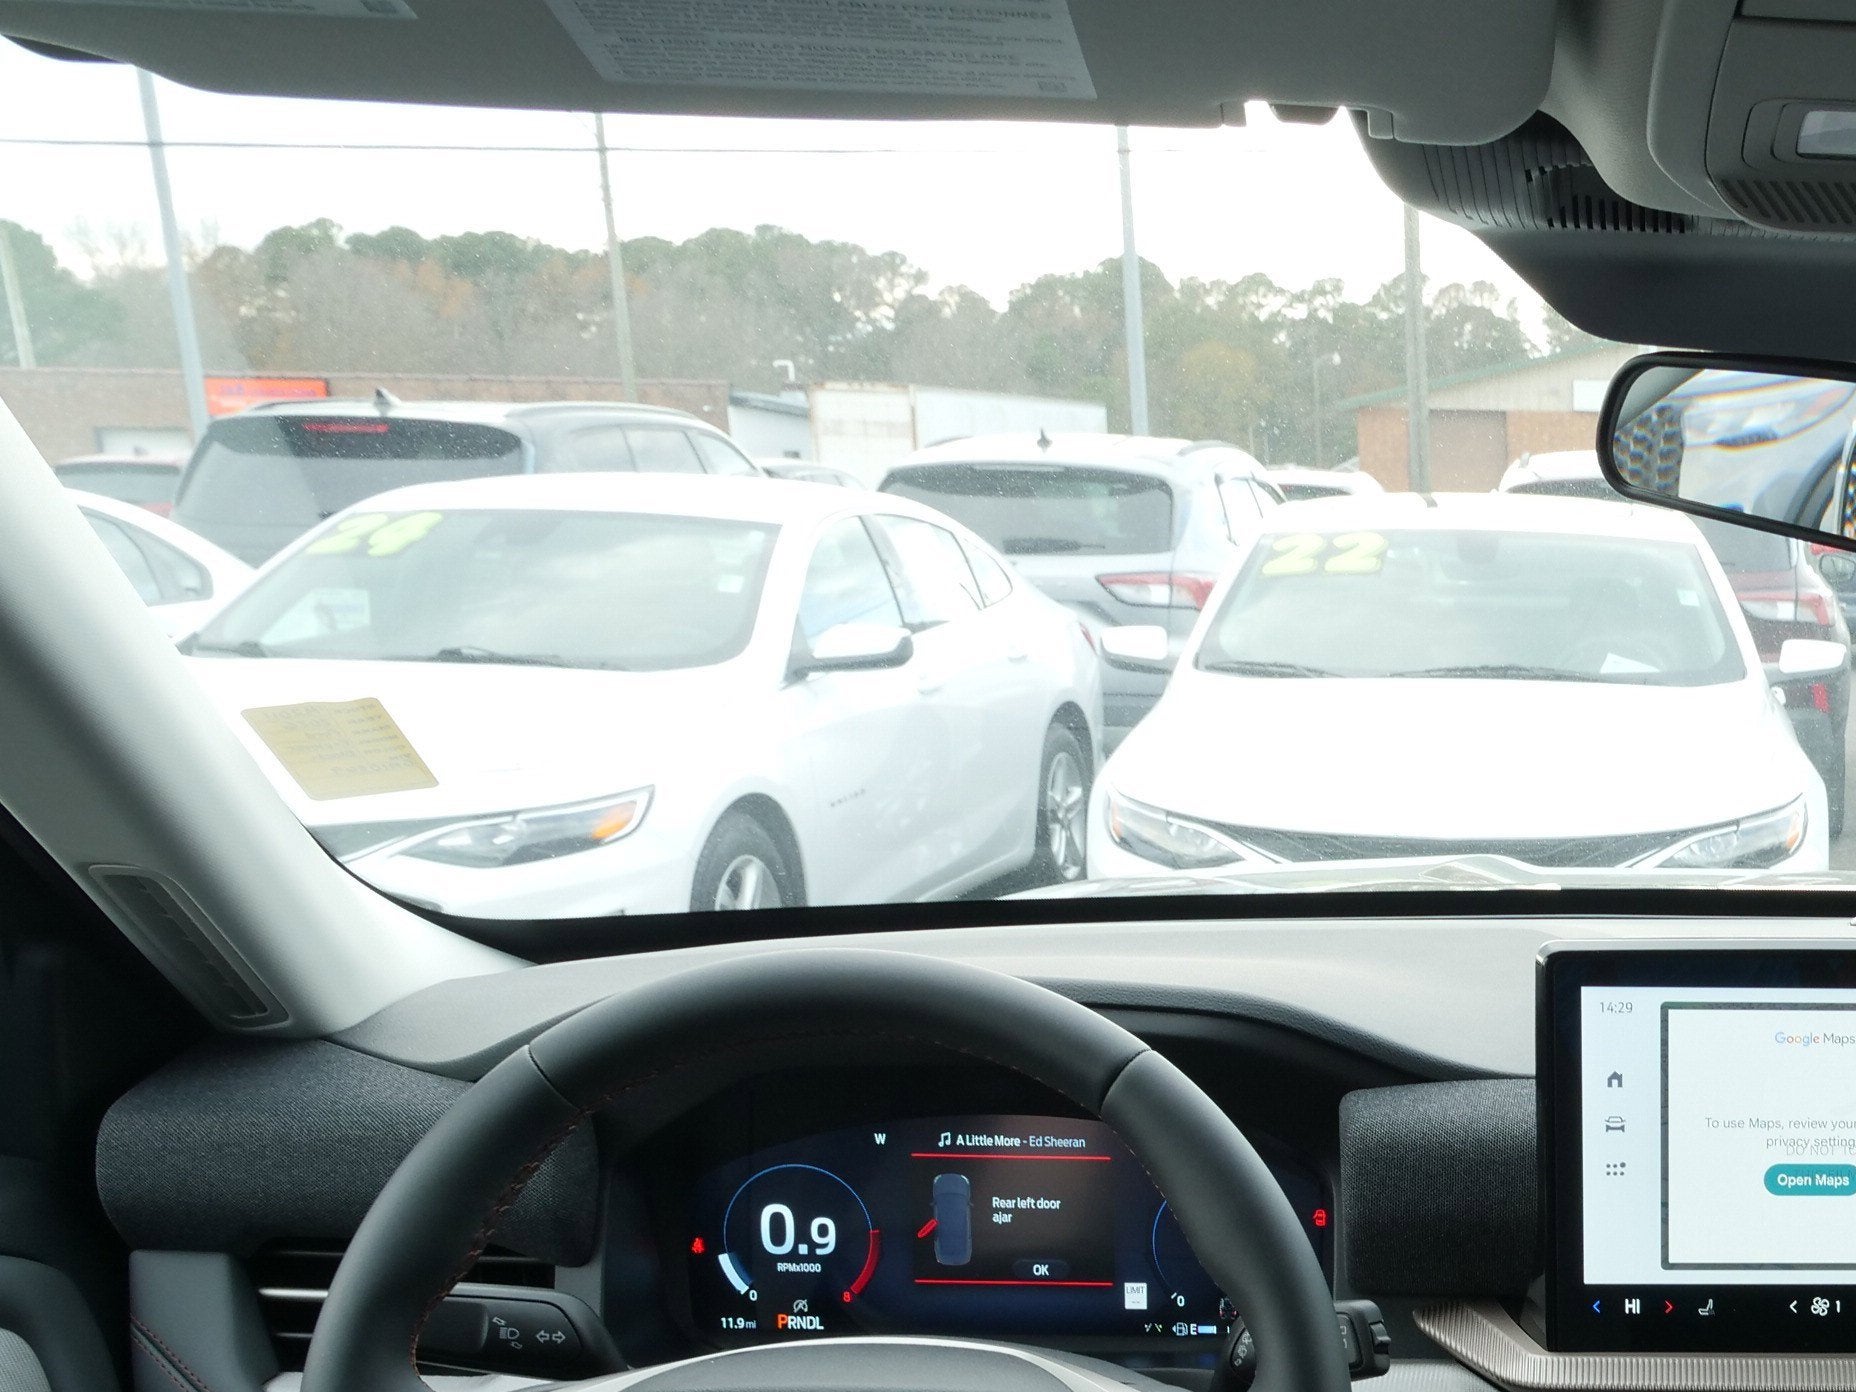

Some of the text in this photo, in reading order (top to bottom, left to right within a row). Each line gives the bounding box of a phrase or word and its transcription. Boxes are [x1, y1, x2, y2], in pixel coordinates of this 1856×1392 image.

[1261, 532, 1389, 576] 22
[1600, 1001, 1633, 1014] 14:29
[1775, 1031, 1856, 1047] Google Maps
[1705, 1117, 1719, 1129] To
[1723, 1120, 1745, 1129] use
[1749, 1118, 1785, 1132] Maps,
[1788, 1118, 1827, 1130] review
[874, 1133, 887, 1145] W
[955, 1134, 964, 1146] A
[965, 1134, 993, 1147] Little
[994, 1135, 1022, 1147] More
[1029, 1135, 1042, 1148] Ed
[1043, 1135, 1086, 1148] Sheeran
[1766, 1136, 1810, 1149] privacy
[1786, 1145, 1805, 1156] DO
[1810, 1145, 1834, 1156] NOT
[1777, 1173, 1850, 1189] Open Maps
[992, 1197, 1061, 1211] Rear left door
[992, 1210, 1012, 1225] ajar
[759, 1203, 837, 1256] 0.9
[777, 1262, 821, 1273] RPMx1000
[1032, 1263, 1050, 1277] OK
[749, 1290, 757, 1301] 0
[1125, 1285, 1145, 1295] LIMIT
[843, 1291, 851, 1303] 8
[1176, 1295, 1185, 1307] 0
[1624, 1298, 1641, 1315] HI
[720, 1317, 757, 1329] 11.9 mi
[777, 1313, 824, 1330] PRNDL
[1190, 1323, 1197, 1336] E
